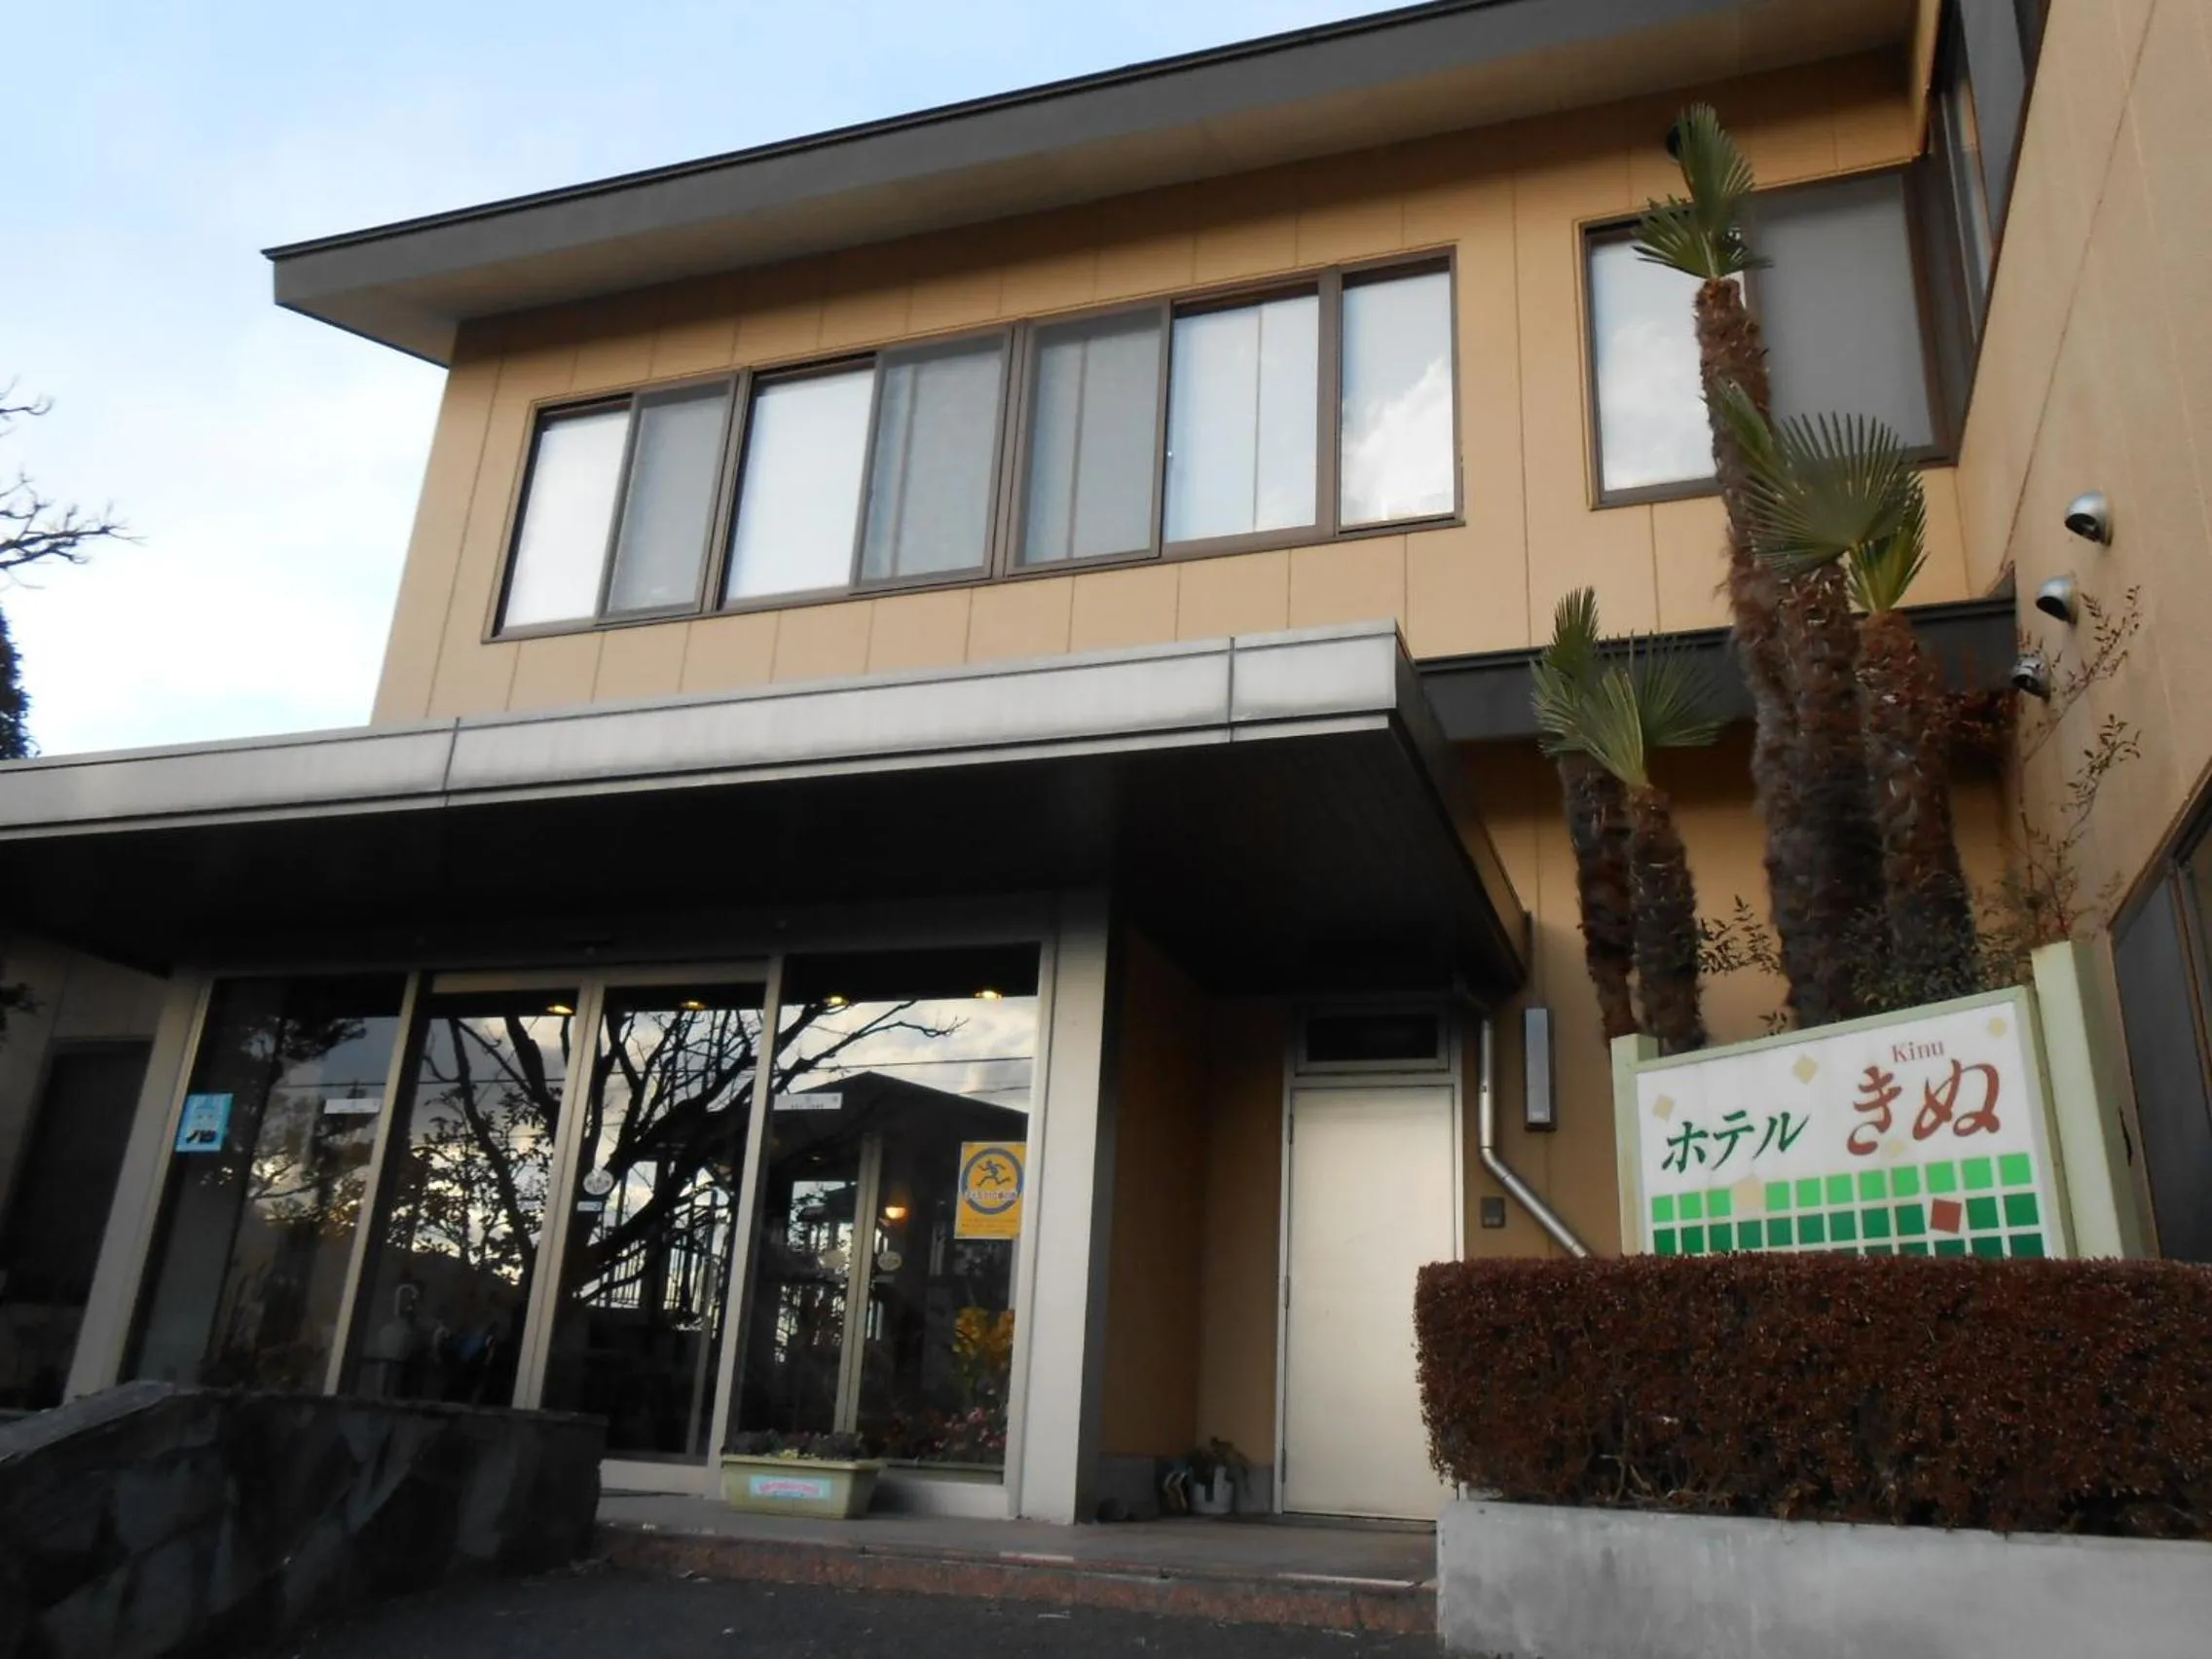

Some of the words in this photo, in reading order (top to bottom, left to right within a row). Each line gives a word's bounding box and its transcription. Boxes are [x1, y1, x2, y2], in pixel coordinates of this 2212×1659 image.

[1892, 1041, 1945, 1063] Kinu
[1661, 1110, 1810, 1173] ホテル
[1846, 1059, 2001, 1156] きぬ
